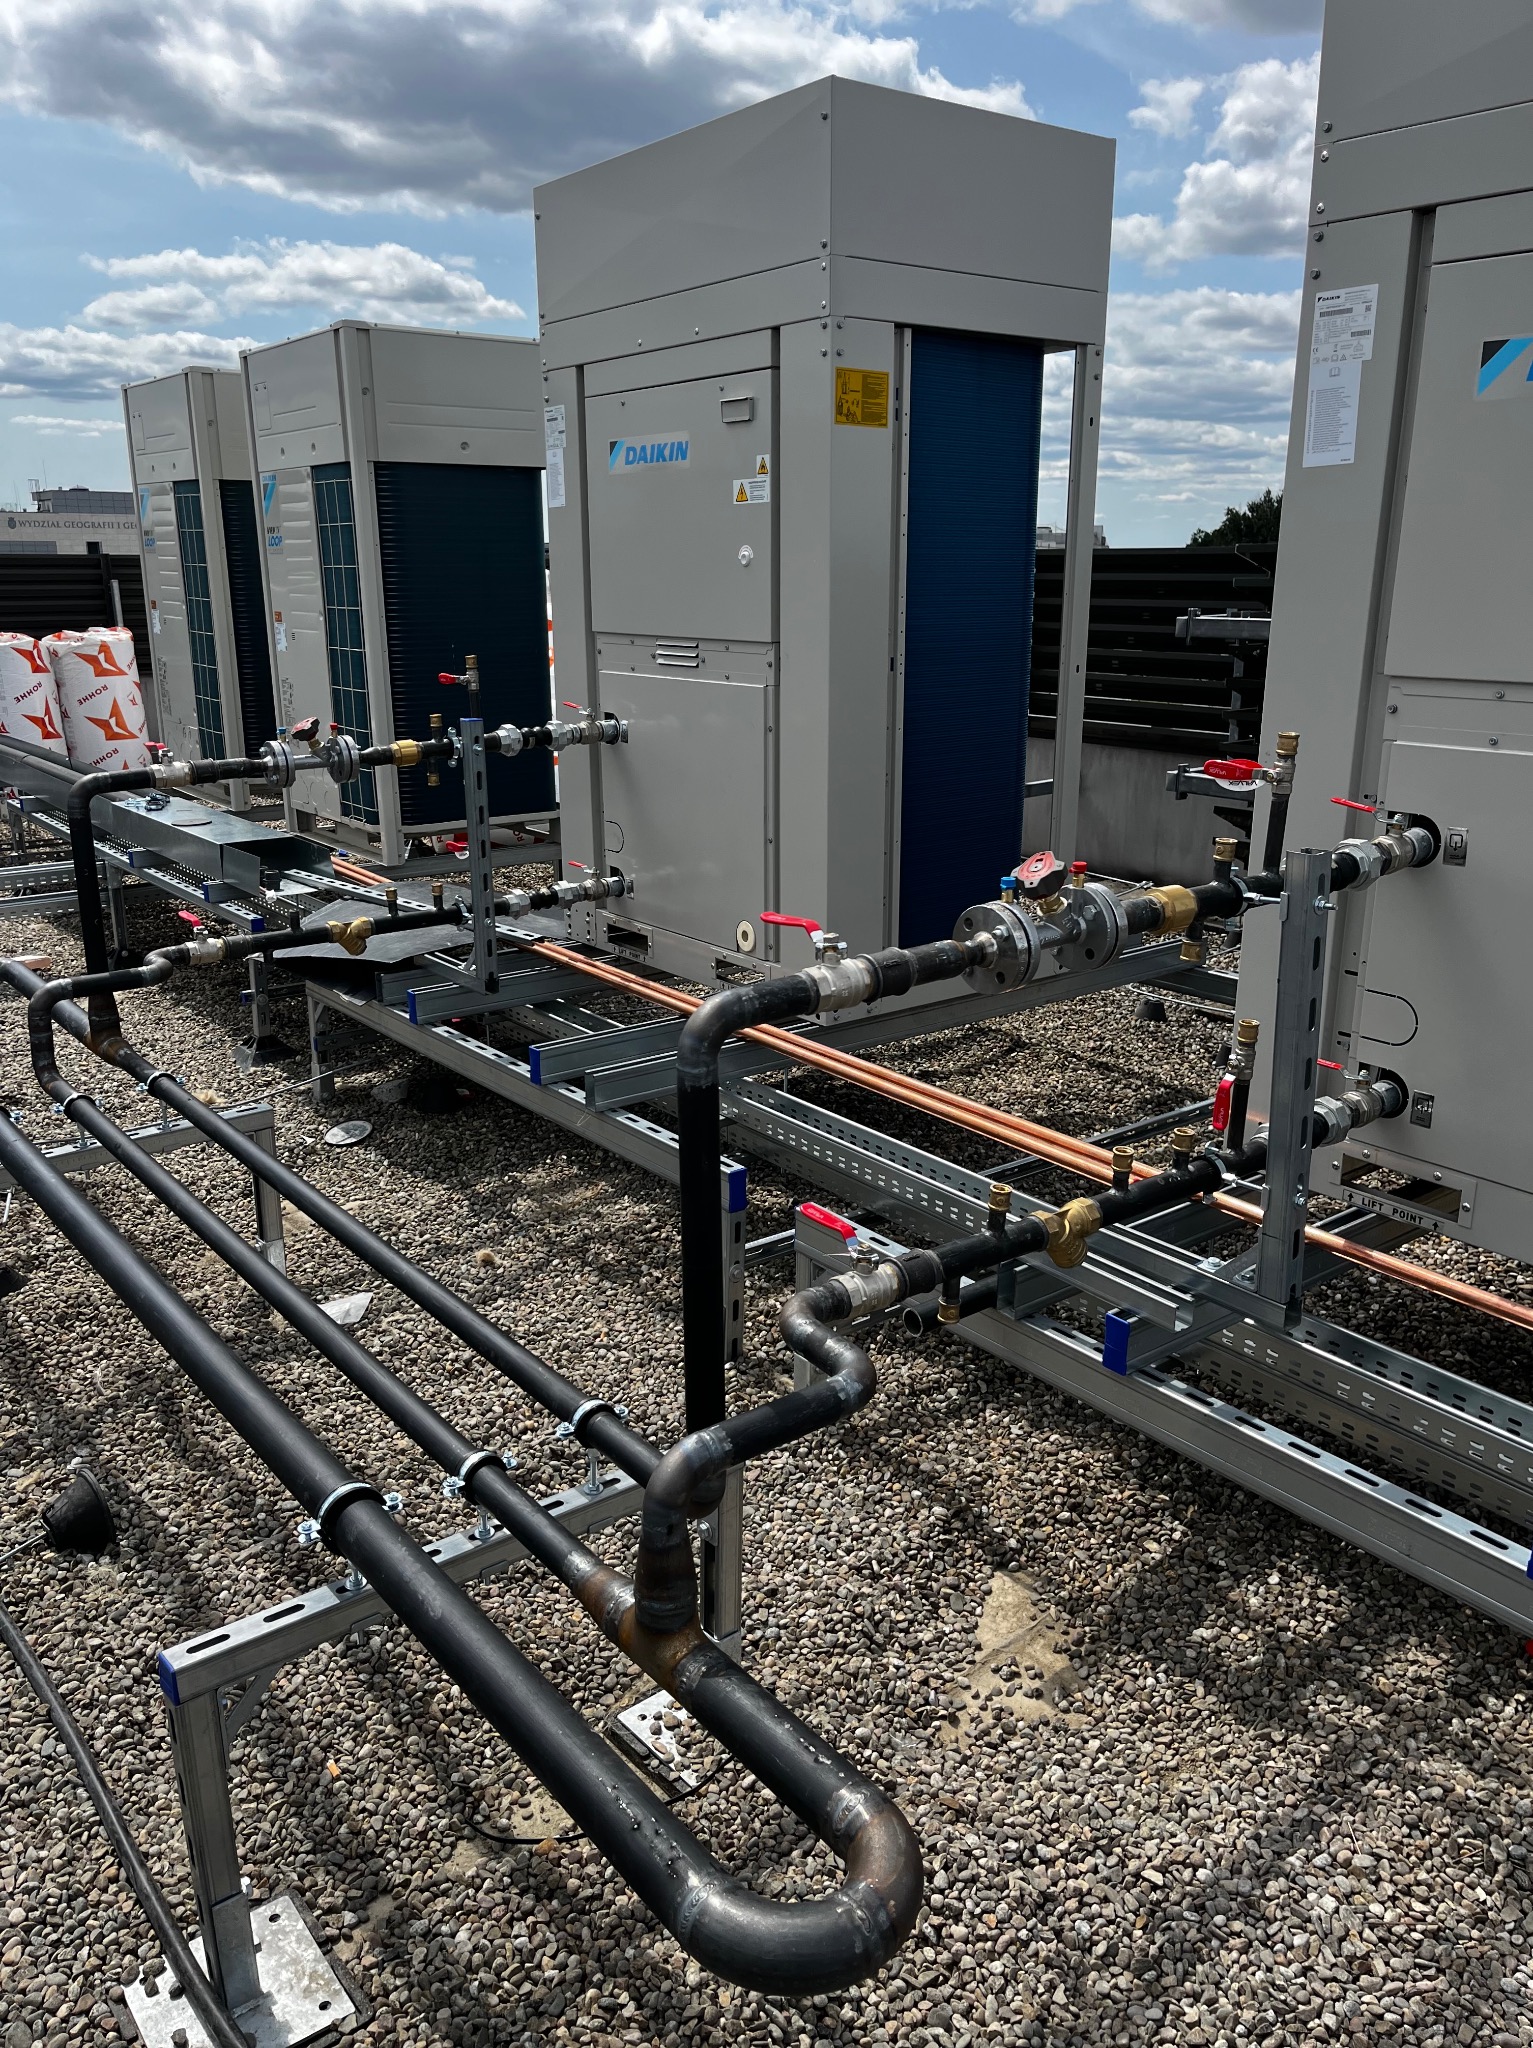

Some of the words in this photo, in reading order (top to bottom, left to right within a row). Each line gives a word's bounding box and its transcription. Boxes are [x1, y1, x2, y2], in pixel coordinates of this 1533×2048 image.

[624, 440, 689, 466] DAIKIN
[64, 520, 114, 529] GEOGRAFII
[123, 521, 138, 530] GE
[268, 535, 283, 547] LOOP
[13, 680, 43, 704] ROHHE
[77, 684, 109, 706] ROHHE
[1361, 1197, 1385, 1212] LIFT
[1392, 1208, 1424, 1225] POINT
